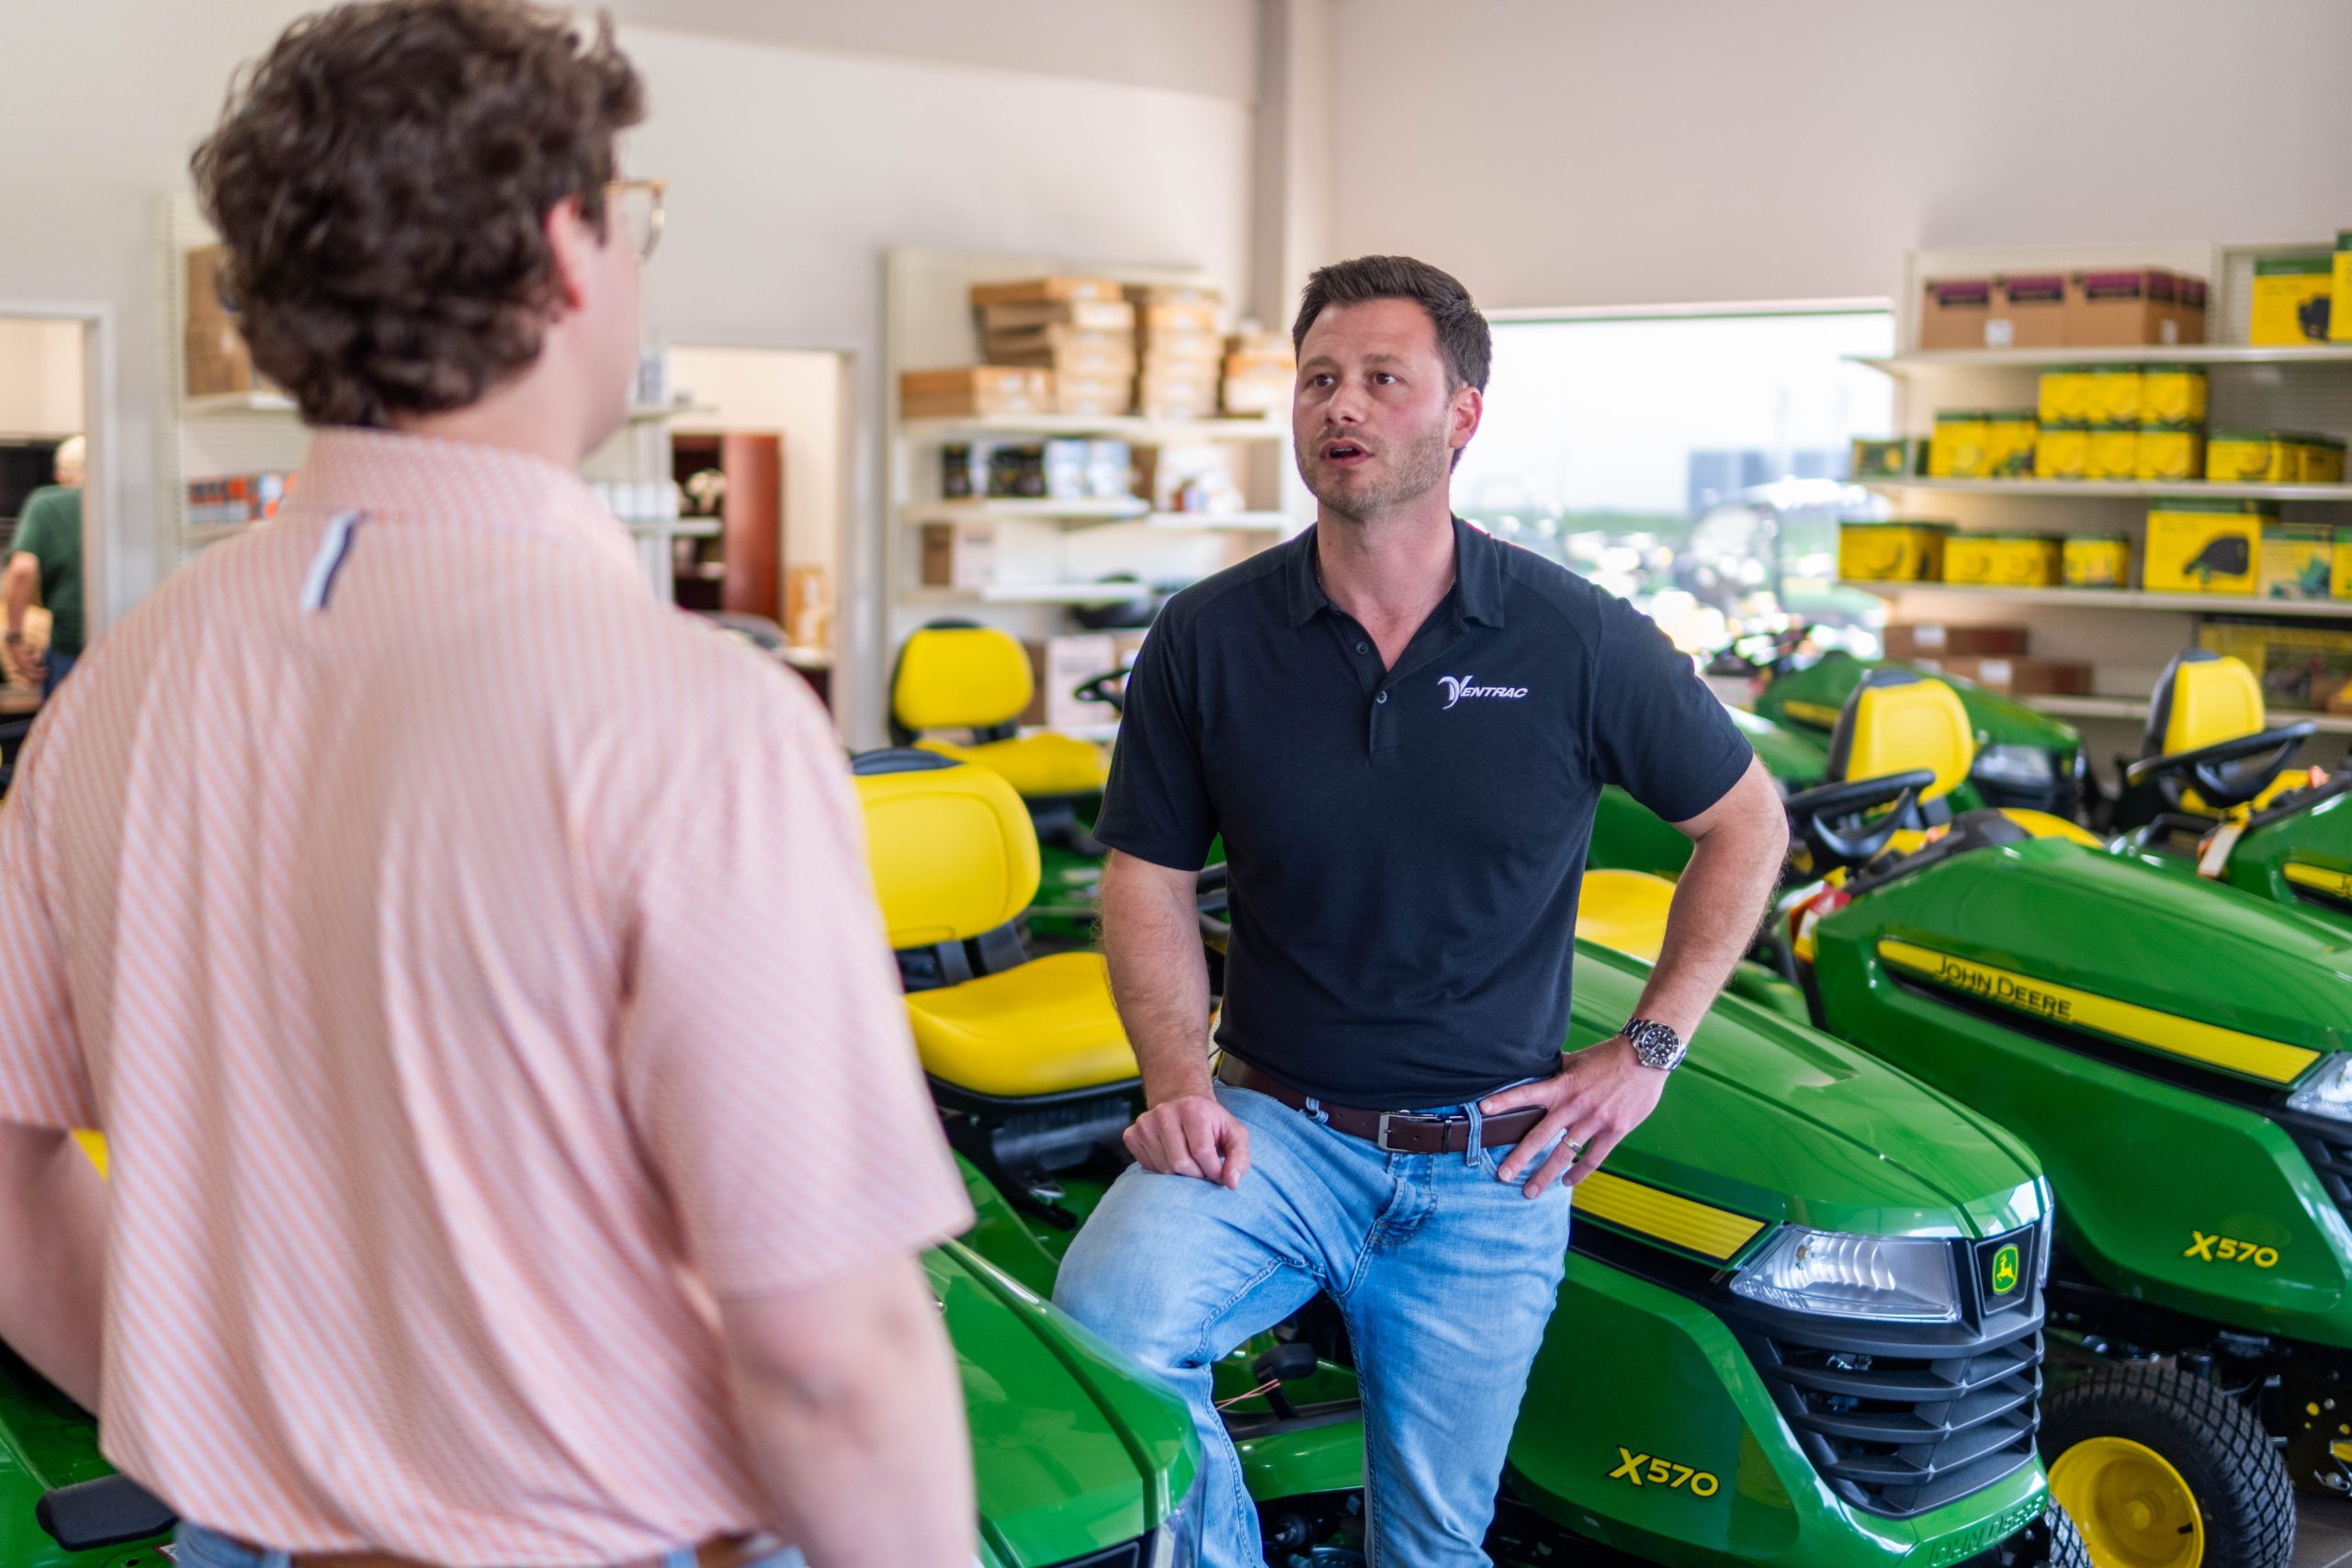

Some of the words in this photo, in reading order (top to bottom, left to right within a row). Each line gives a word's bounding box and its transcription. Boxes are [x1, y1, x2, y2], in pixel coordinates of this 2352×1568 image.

[1438, 675, 1528, 709] VENTRAC
[1935, 955, 1992, 992] JOHN
[1997, 975, 2072, 1016] DEERE
[2182, 1229, 2279, 1269] X570
[1607, 1445, 1719, 1497] X570
